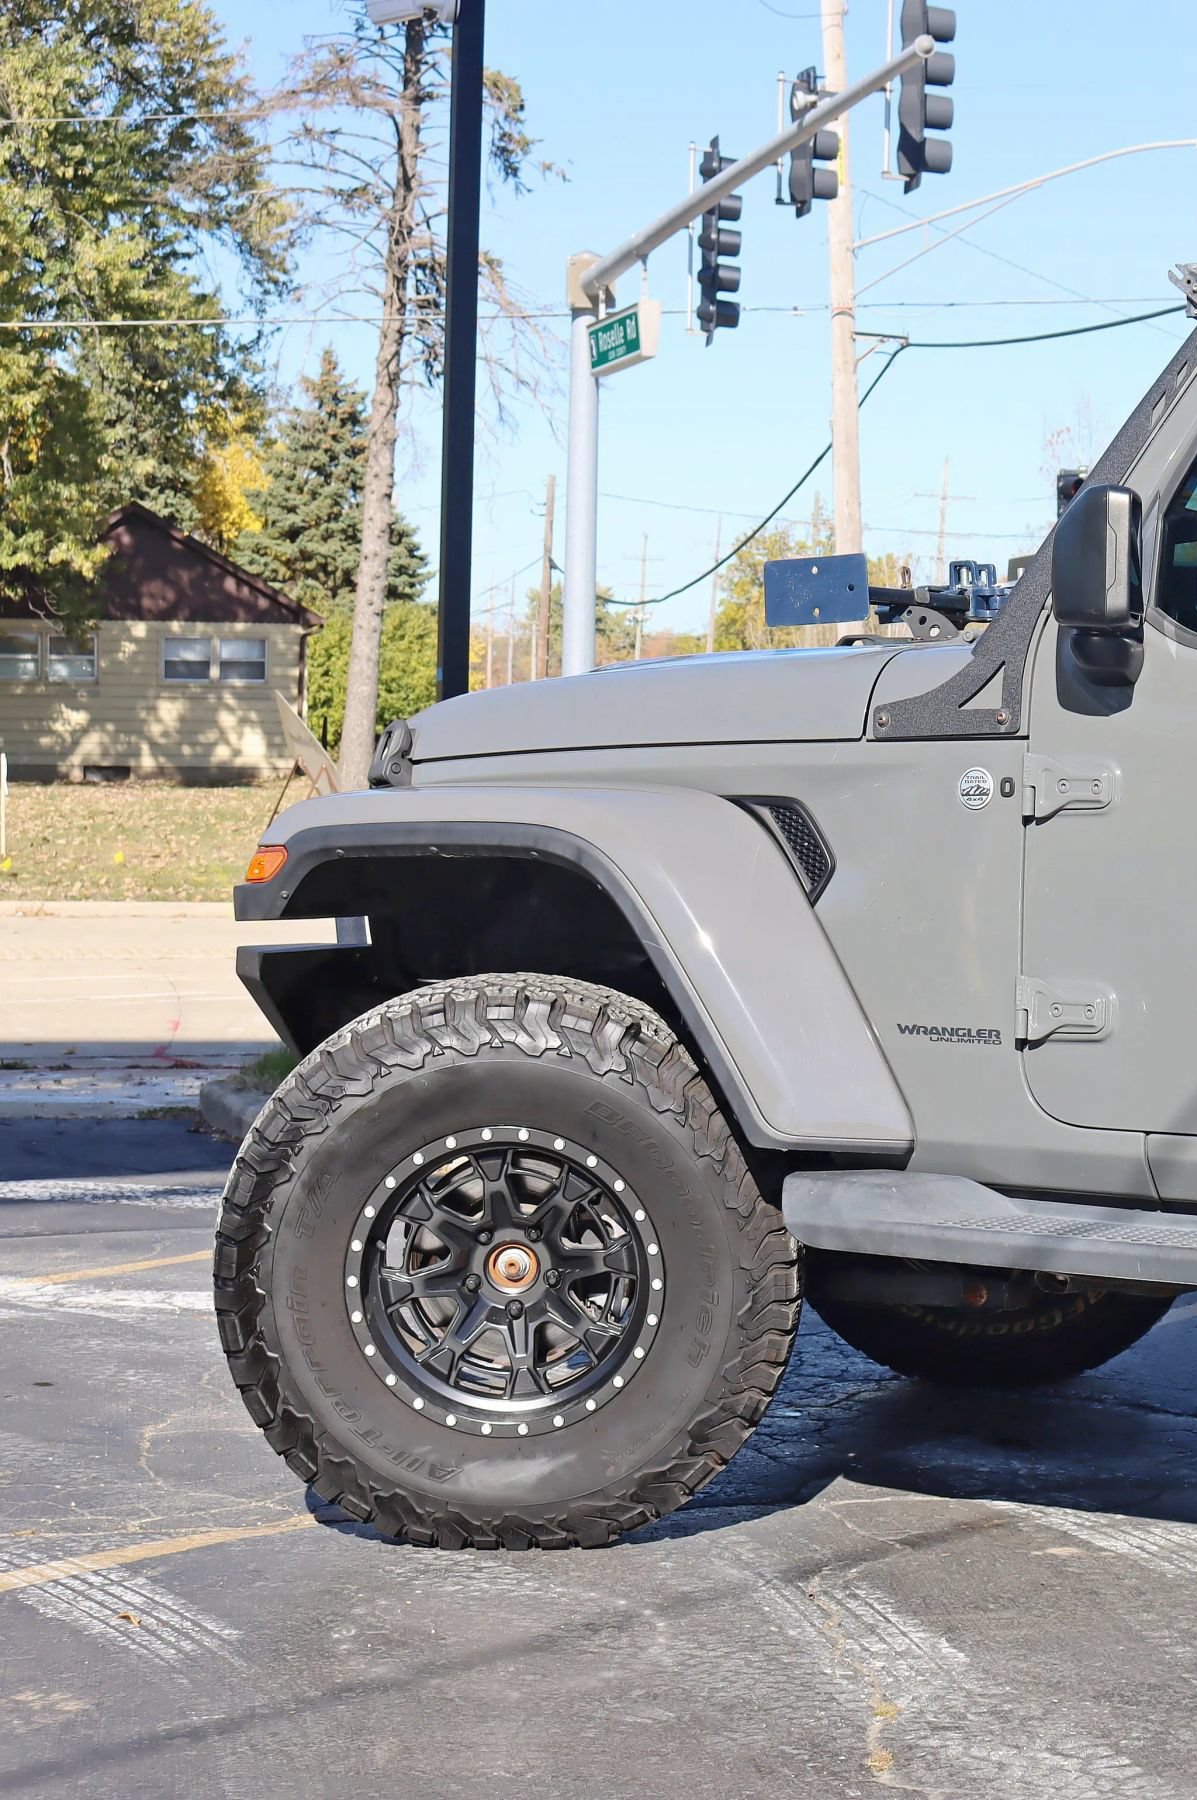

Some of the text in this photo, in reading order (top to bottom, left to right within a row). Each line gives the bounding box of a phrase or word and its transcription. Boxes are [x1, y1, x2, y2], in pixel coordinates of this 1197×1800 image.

[598, 314, 637, 352] Roselle Rd
[896, 1023, 1002, 1040] WRANGLER
[929, 1036, 1002, 1046] UNLIMITED
